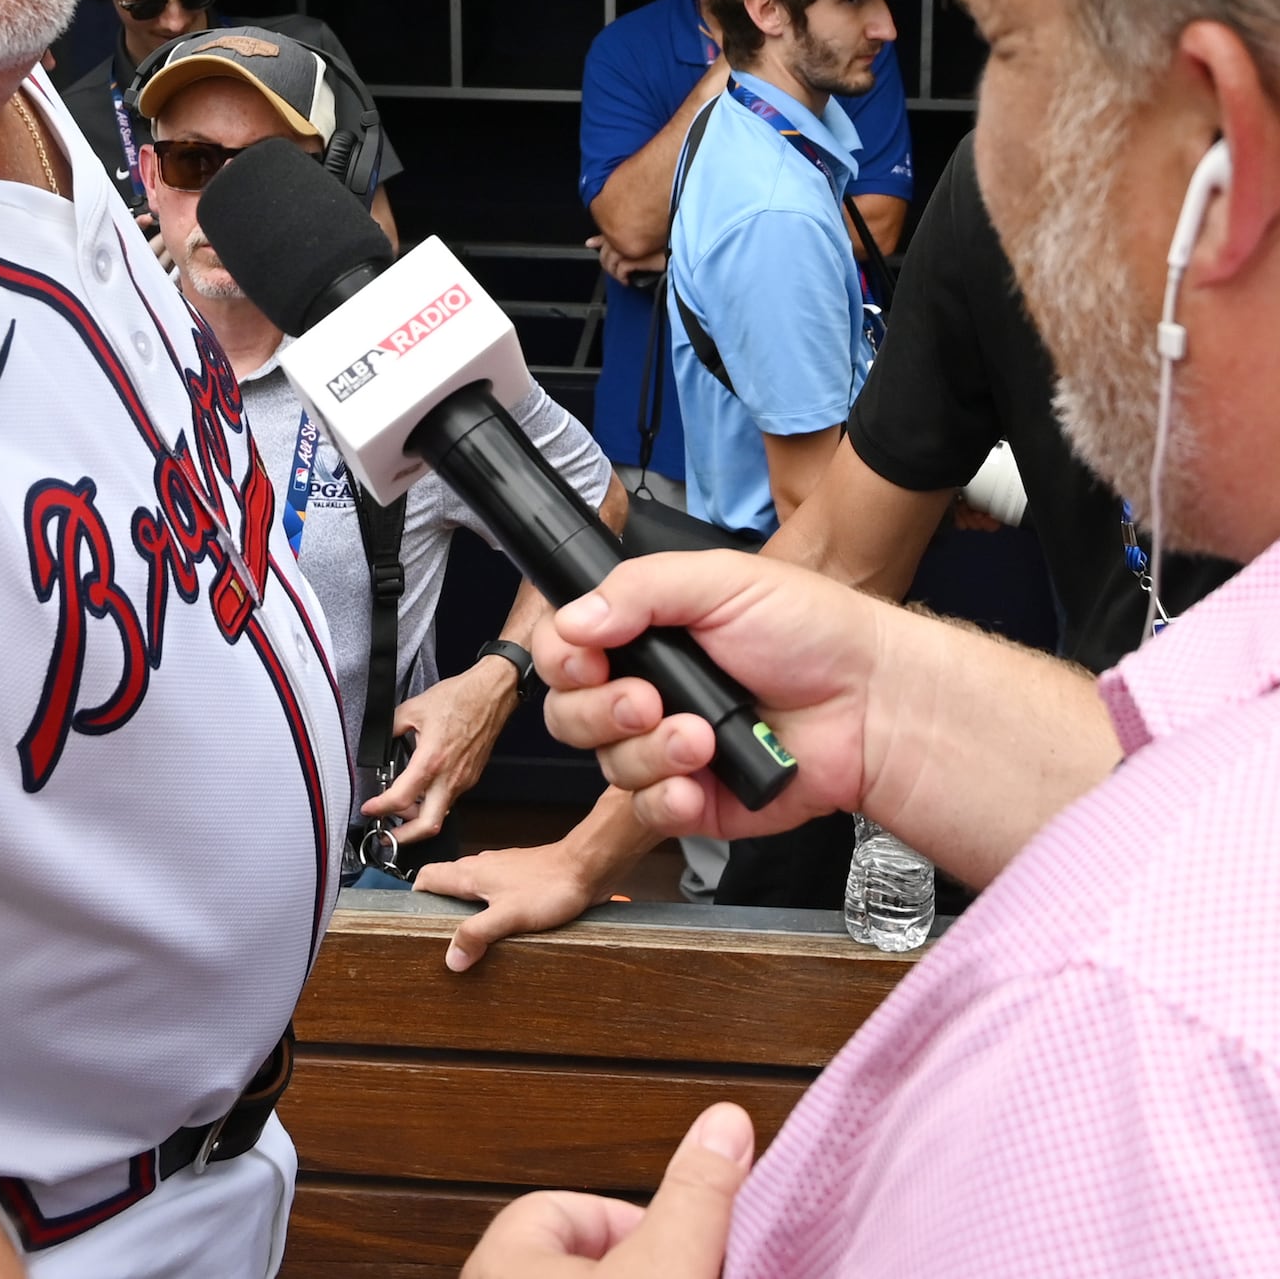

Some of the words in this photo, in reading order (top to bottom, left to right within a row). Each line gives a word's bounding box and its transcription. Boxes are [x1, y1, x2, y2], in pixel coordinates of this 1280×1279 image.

[390, 288, 467, 353] RADIO
[328, 359, 367, 396] MLB
[298, 440, 313, 468] All
[308, 482, 354, 499] PGA
[312, 501, 348, 510] VALHALLA
